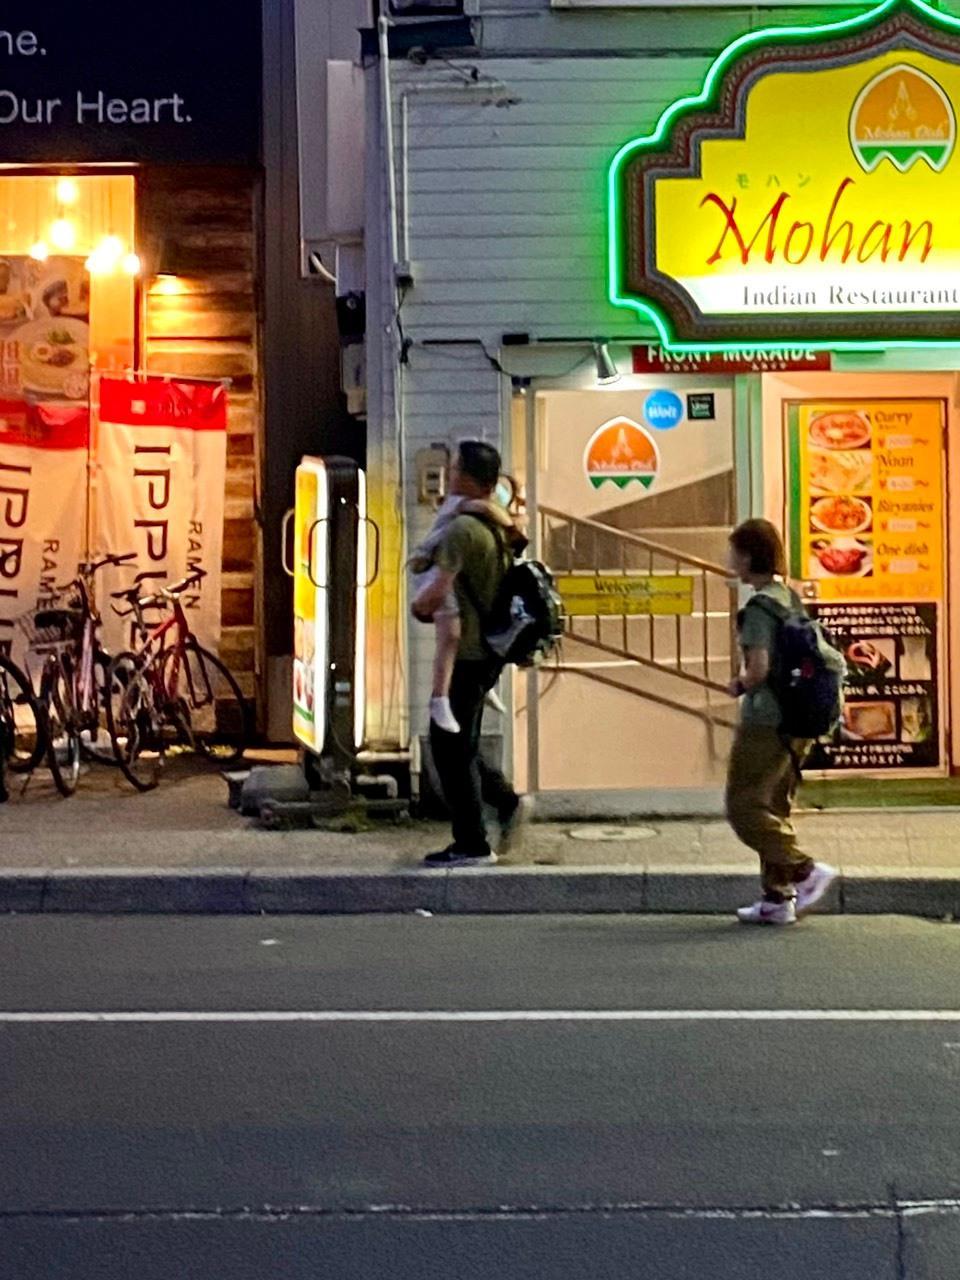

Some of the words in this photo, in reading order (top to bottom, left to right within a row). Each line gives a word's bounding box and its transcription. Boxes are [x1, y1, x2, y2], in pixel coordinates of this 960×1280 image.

[0, 89, 62, 123] Our
[77, 90, 192, 123] Heart.
[736, 173, 812, 189] モハン
[700, 176, 933, 265] Mohan
[743, 284, 817, 306] Indian
[828, 284, 959, 305] Restaurant
